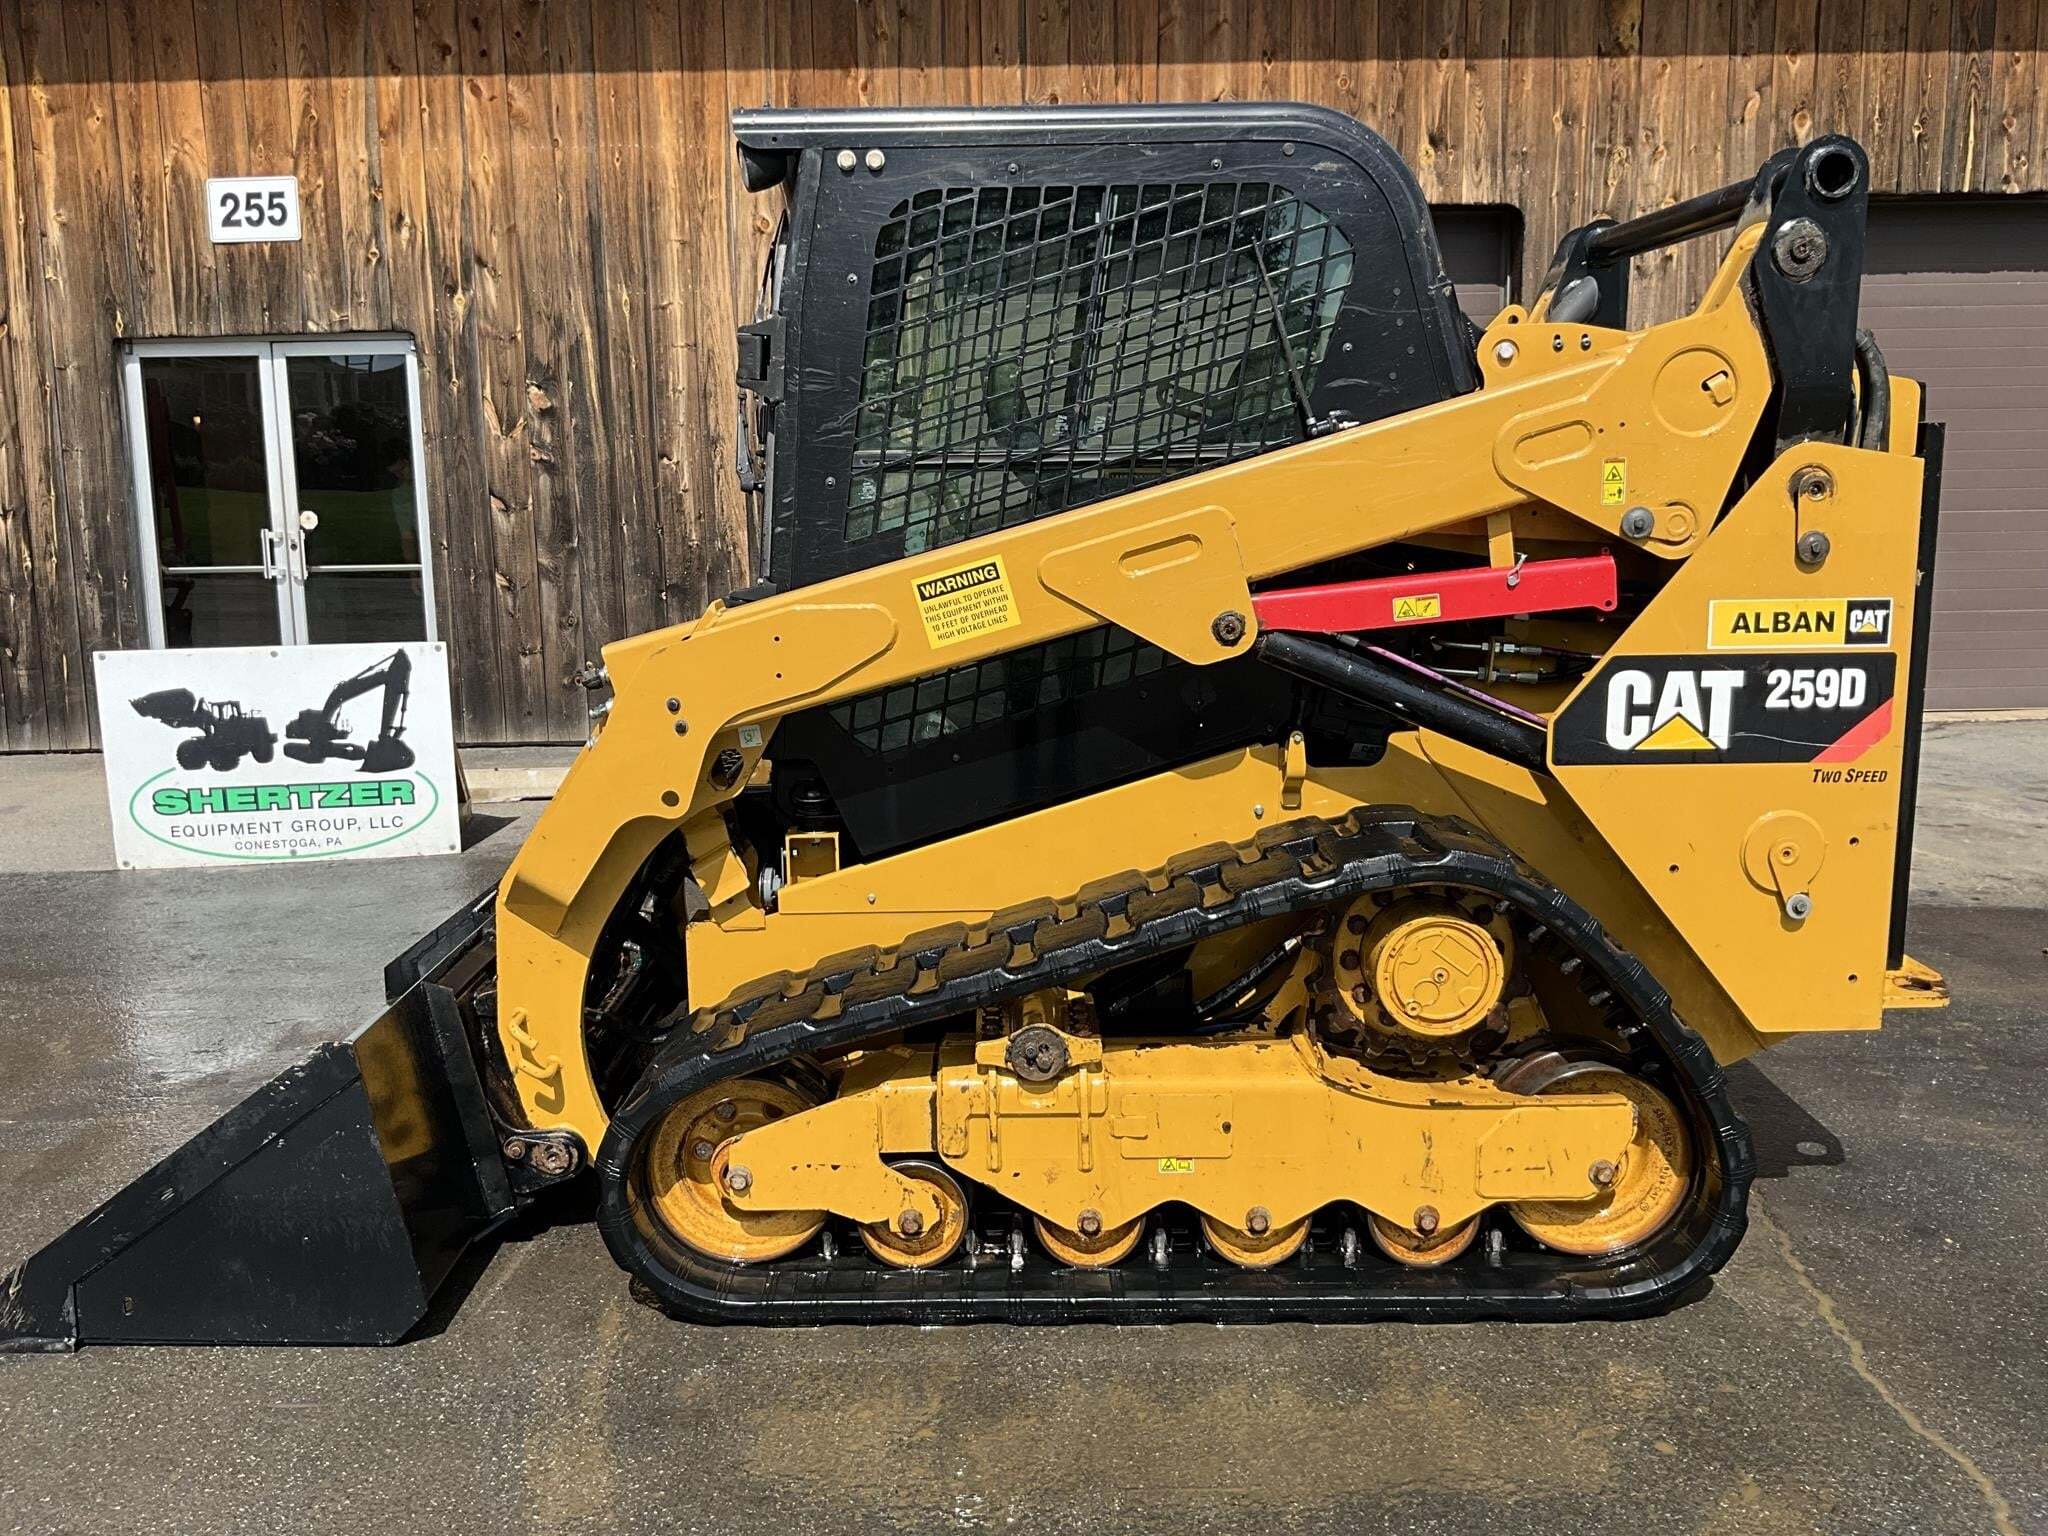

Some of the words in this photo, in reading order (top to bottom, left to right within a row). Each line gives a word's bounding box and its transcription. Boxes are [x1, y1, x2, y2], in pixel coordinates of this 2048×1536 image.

[220, 191, 288, 227] 255
[920, 565, 997, 598] WARNING
[923, 596, 961, 614] UNLAWFUL
[962, 594, 973, 603] TO
[974, 584, 1005, 600] OPERATE
[925, 613, 941, 624] THIS
[943, 602, 981, 620] EQUIPMENT
[983, 594, 1009, 608] WITHIN
[932, 623, 940, 632] 10
[941, 618, 958, 629] FEET
[960, 614, 971, 624] OF
[971, 604, 1008, 622] OVERHEAD
[937, 630, 956, 641] HIGH
[956, 620, 986, 636] VOLTAGE
[987, 615, 1008, 627] LINES
[1730, 611, 1835, 633] ALBAN
[1850, 609, 1889, 633] CAT
[1605, 670, 1745, 751] CAT
[1764, 668, 1867, 709] 259D
[152, 779, 416, 815] SHERTZER
[170, 821, 283, 838] EQUIPMENT
[291, 817, 361, 834] GROUP,
[369, 815, 404, 829] LLC
[234, 838, 321, 851] CONESTOGA,
[325, 837, 343, 847] PA
